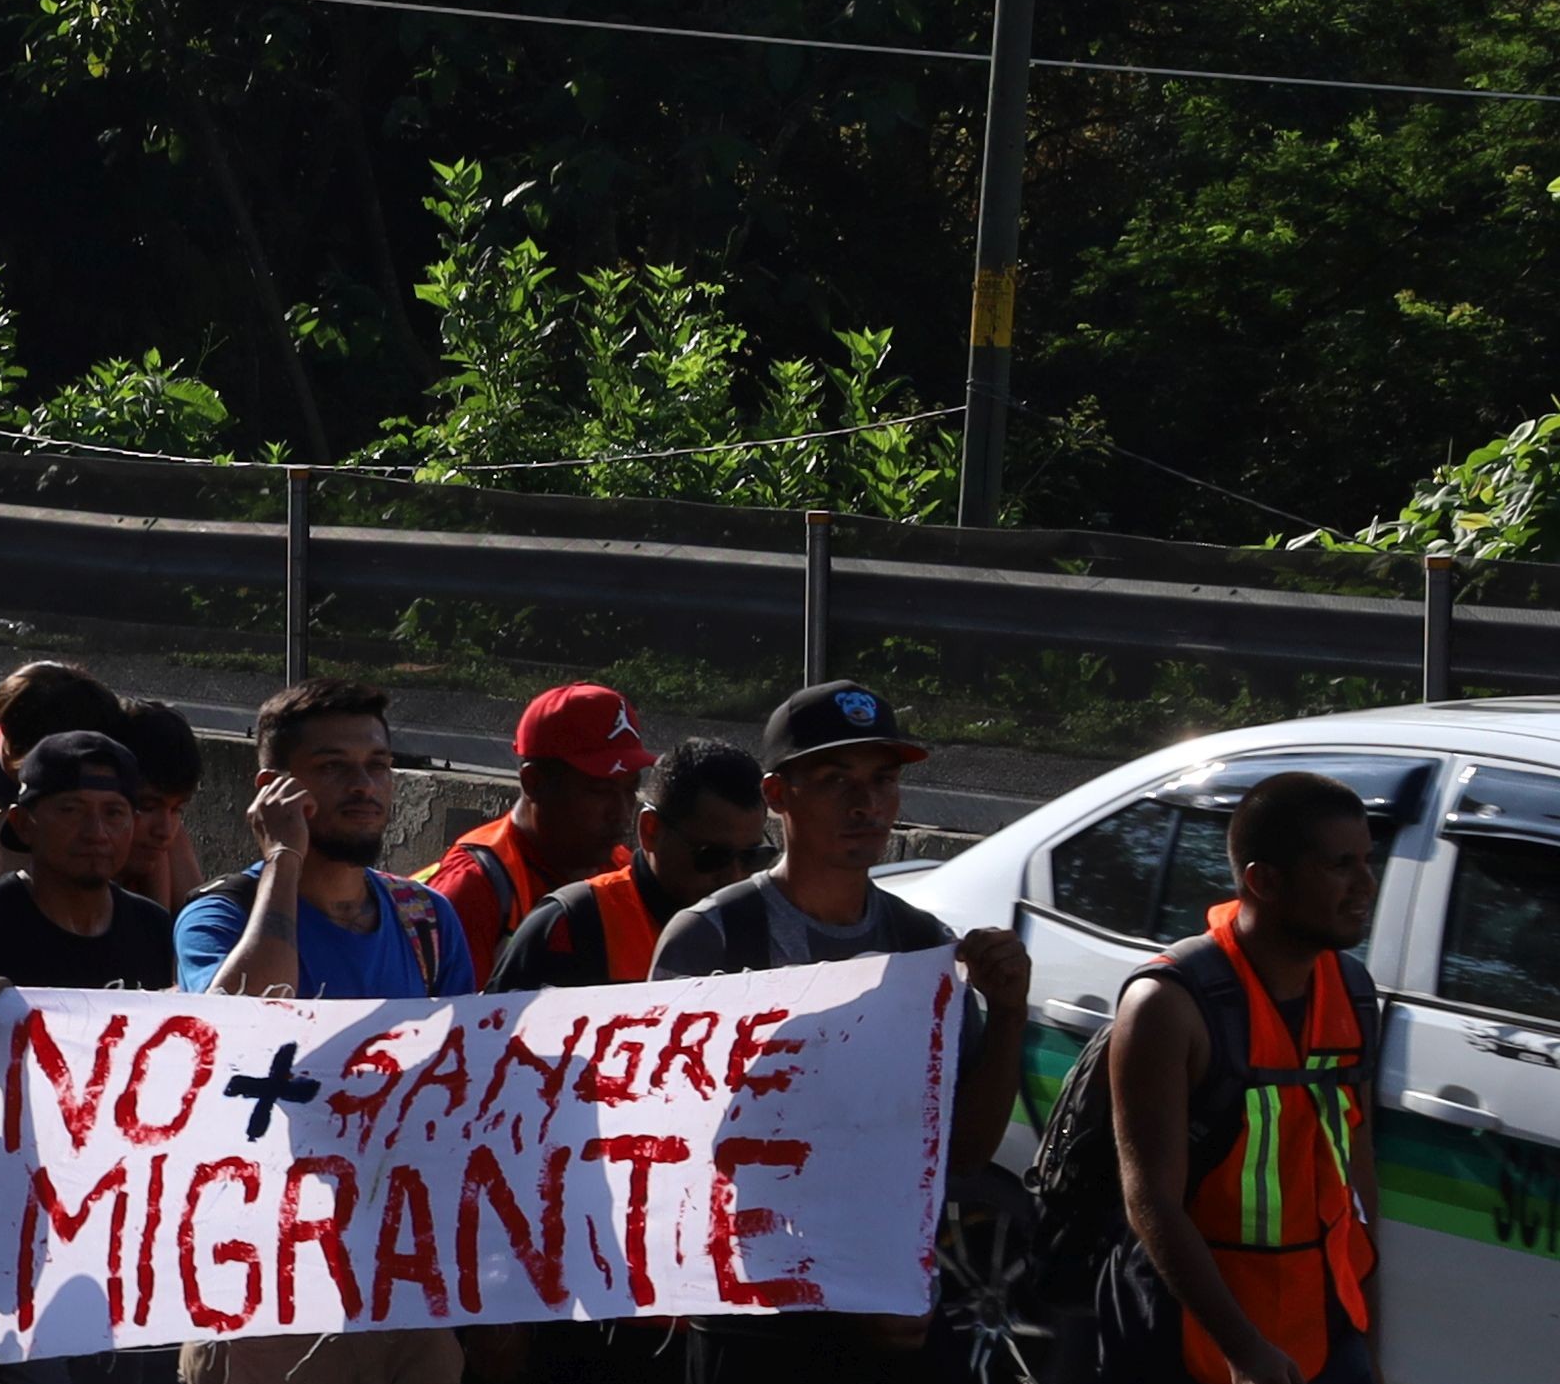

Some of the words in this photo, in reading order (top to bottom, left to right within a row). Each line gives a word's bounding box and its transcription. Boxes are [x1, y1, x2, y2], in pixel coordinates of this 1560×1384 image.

[4, 1007, 220, 1153] NO
[328, 1006, 806, 1133] SANGRE
[16, 1134, 828, 1333] MIGRANTE
